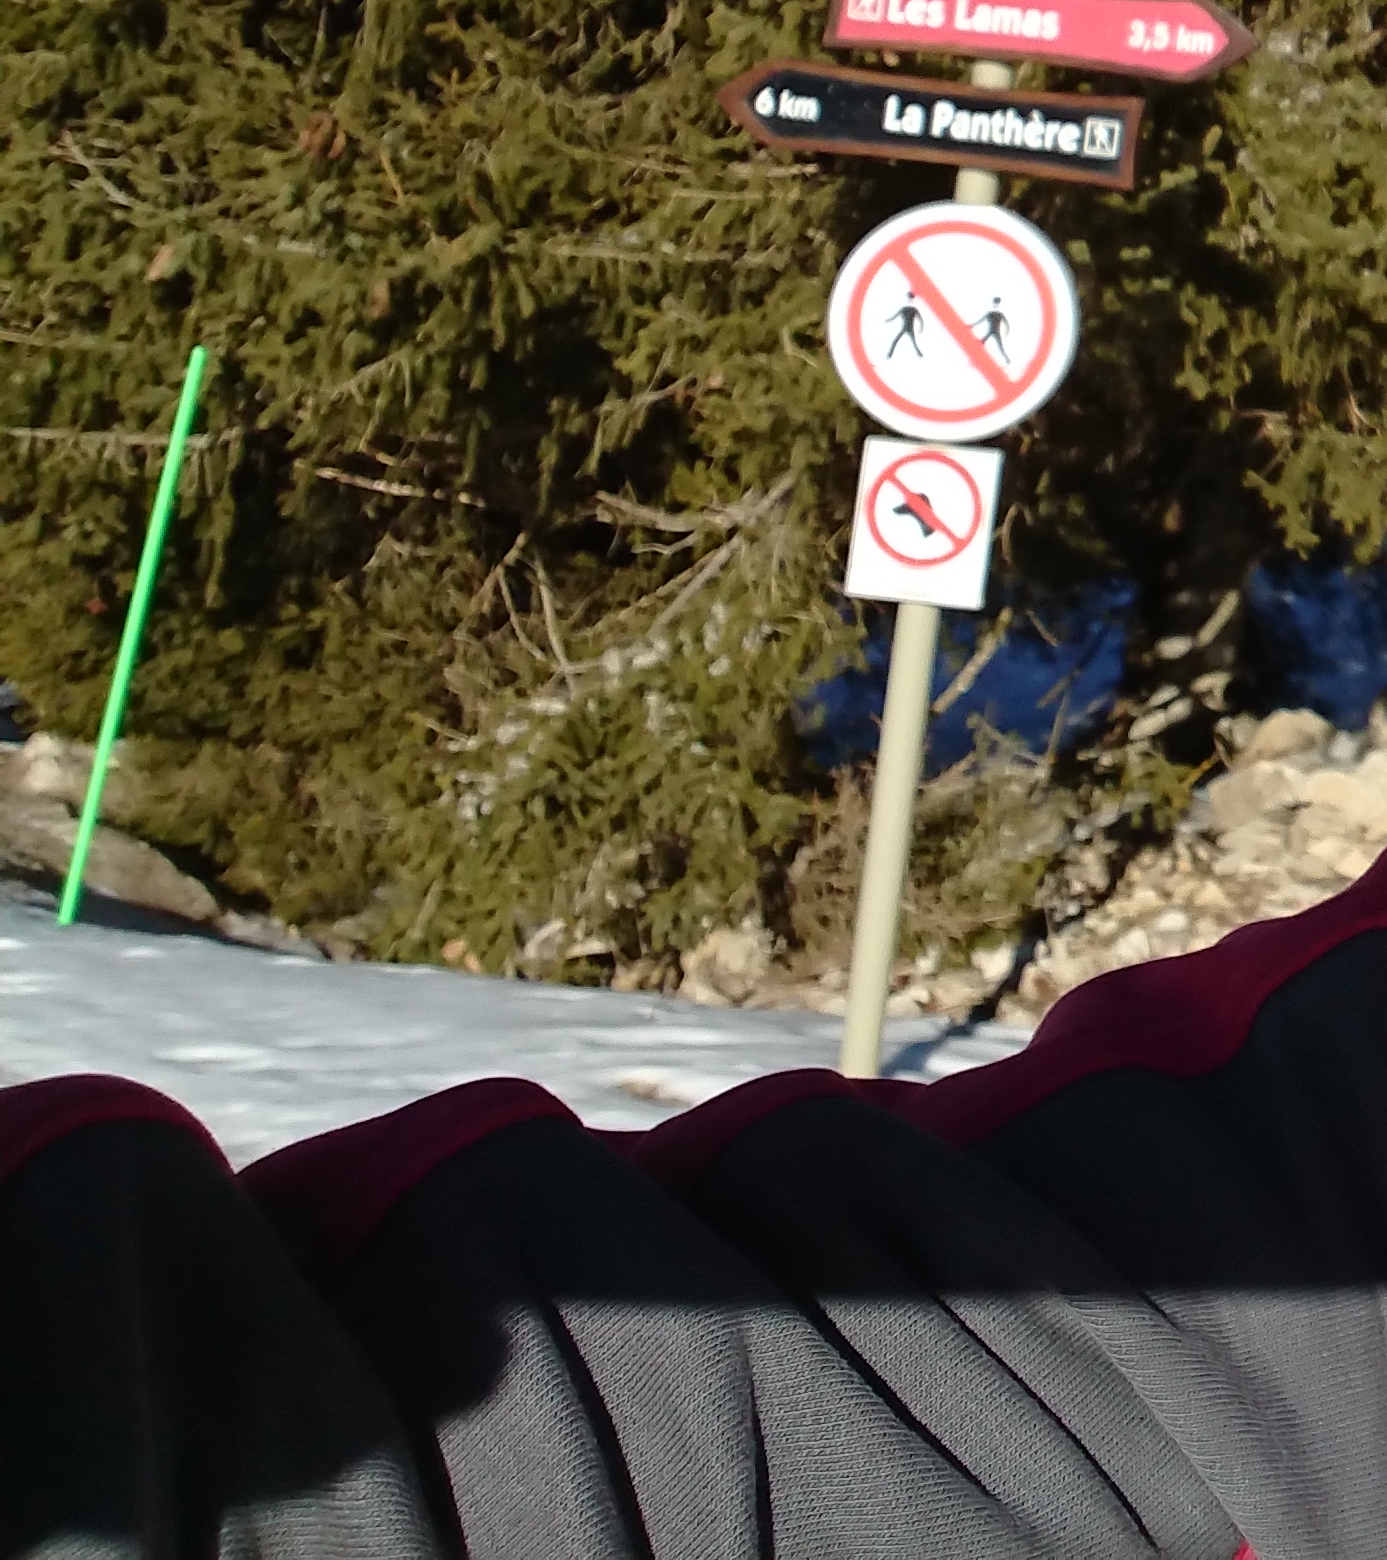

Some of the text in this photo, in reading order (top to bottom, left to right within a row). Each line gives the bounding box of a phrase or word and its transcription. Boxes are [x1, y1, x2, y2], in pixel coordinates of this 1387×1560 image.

[1127, 19, 1214, 55] 3,5 km
[754, 86, 820, 123] 6 km
[882, 94, 1081, 153] La Panthère
